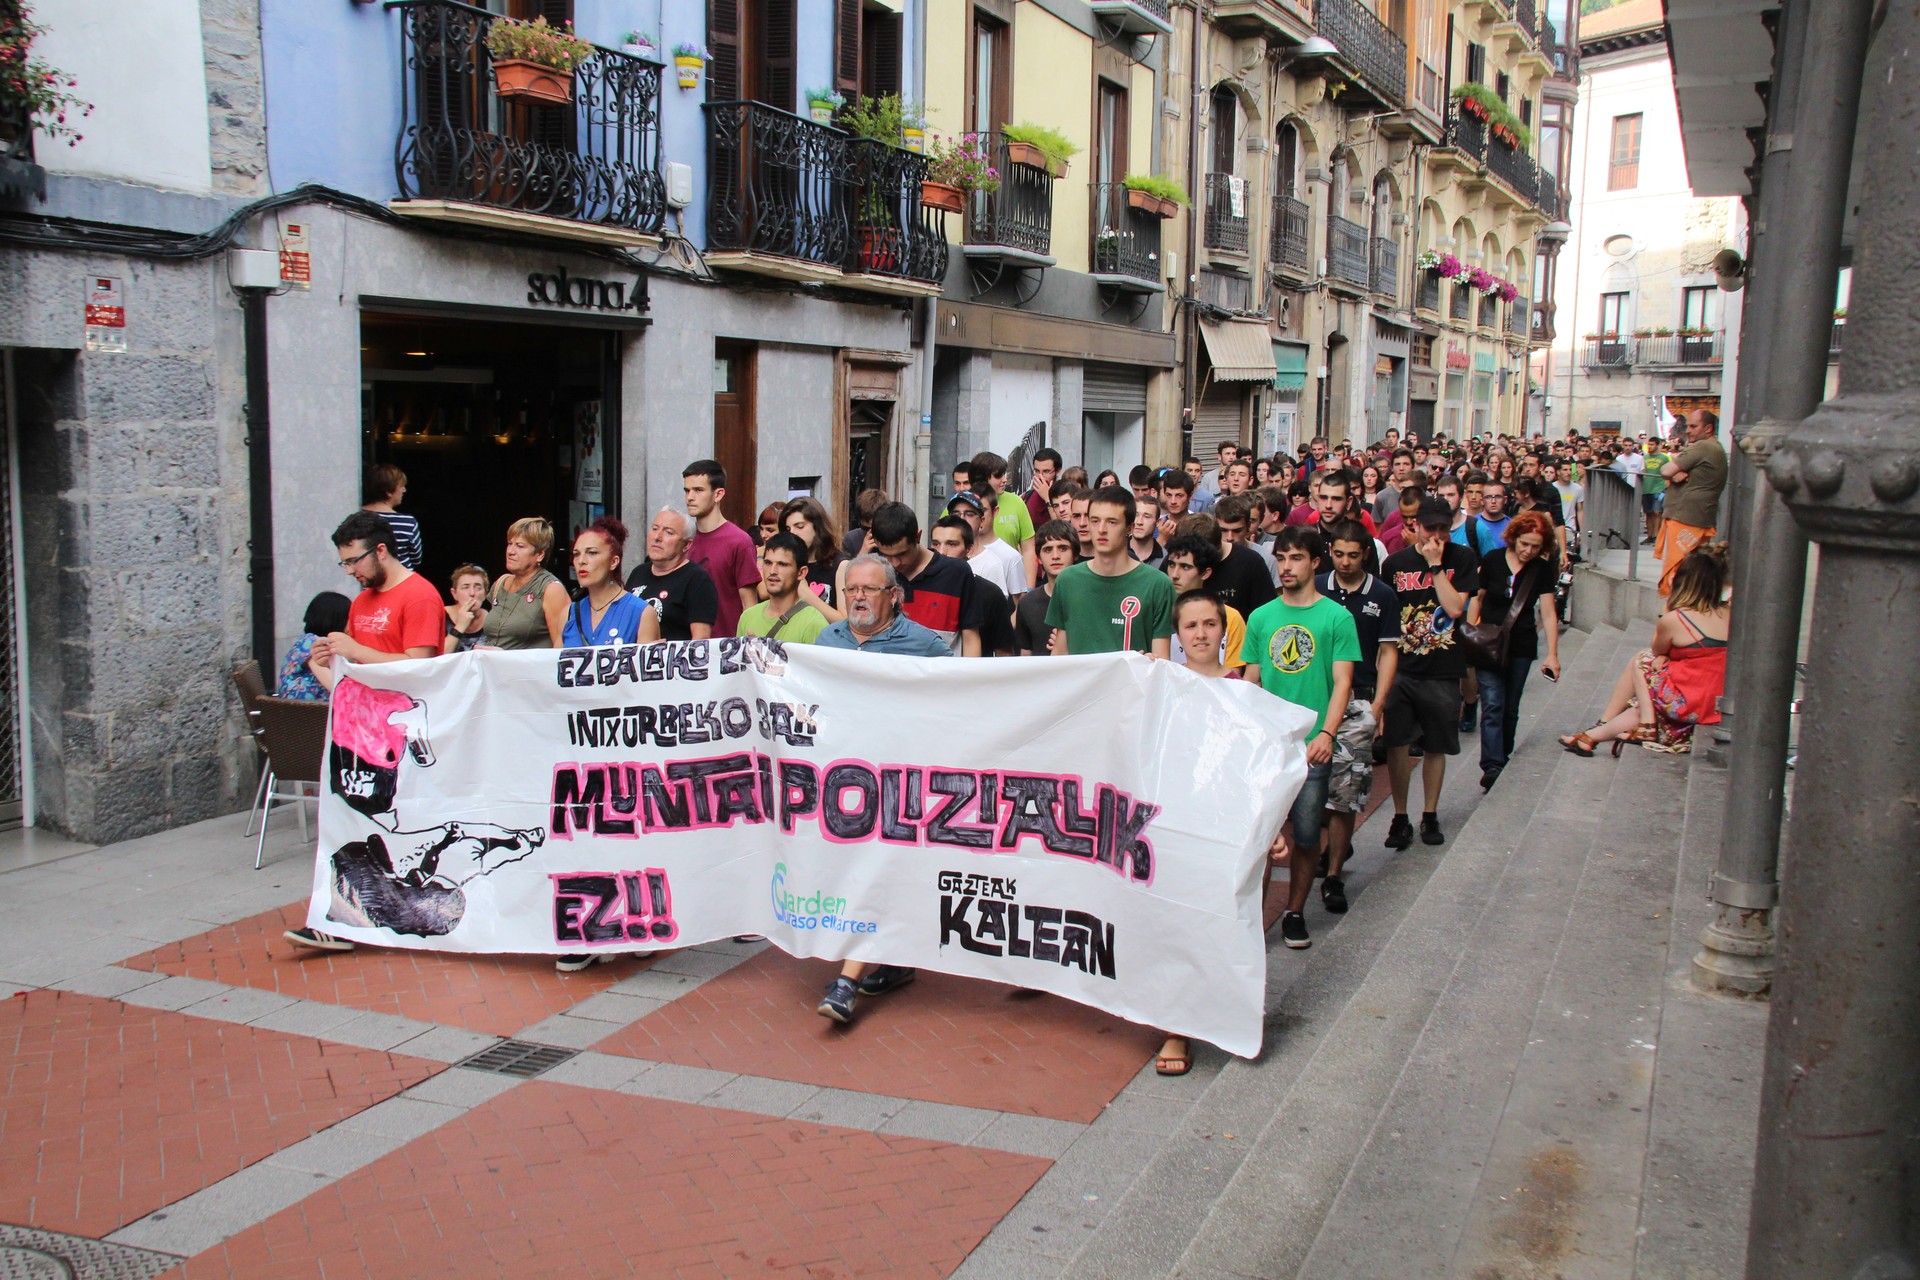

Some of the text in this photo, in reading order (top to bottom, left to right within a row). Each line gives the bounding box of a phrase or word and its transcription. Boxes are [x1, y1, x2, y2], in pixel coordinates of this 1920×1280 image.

[1125, 599, 1137, 614] 7
[557, 639, 710, 687] EZPALAKO
[567, 697, 752, 747] INTXURREKO
[777, 757, 1161, 887] POLIZIALIK
[550, 867, 679, 945] EZ!!
[938, 871, 1016, 900] GAZTEAK
[940, 895, 1116, 980] KALEAN
